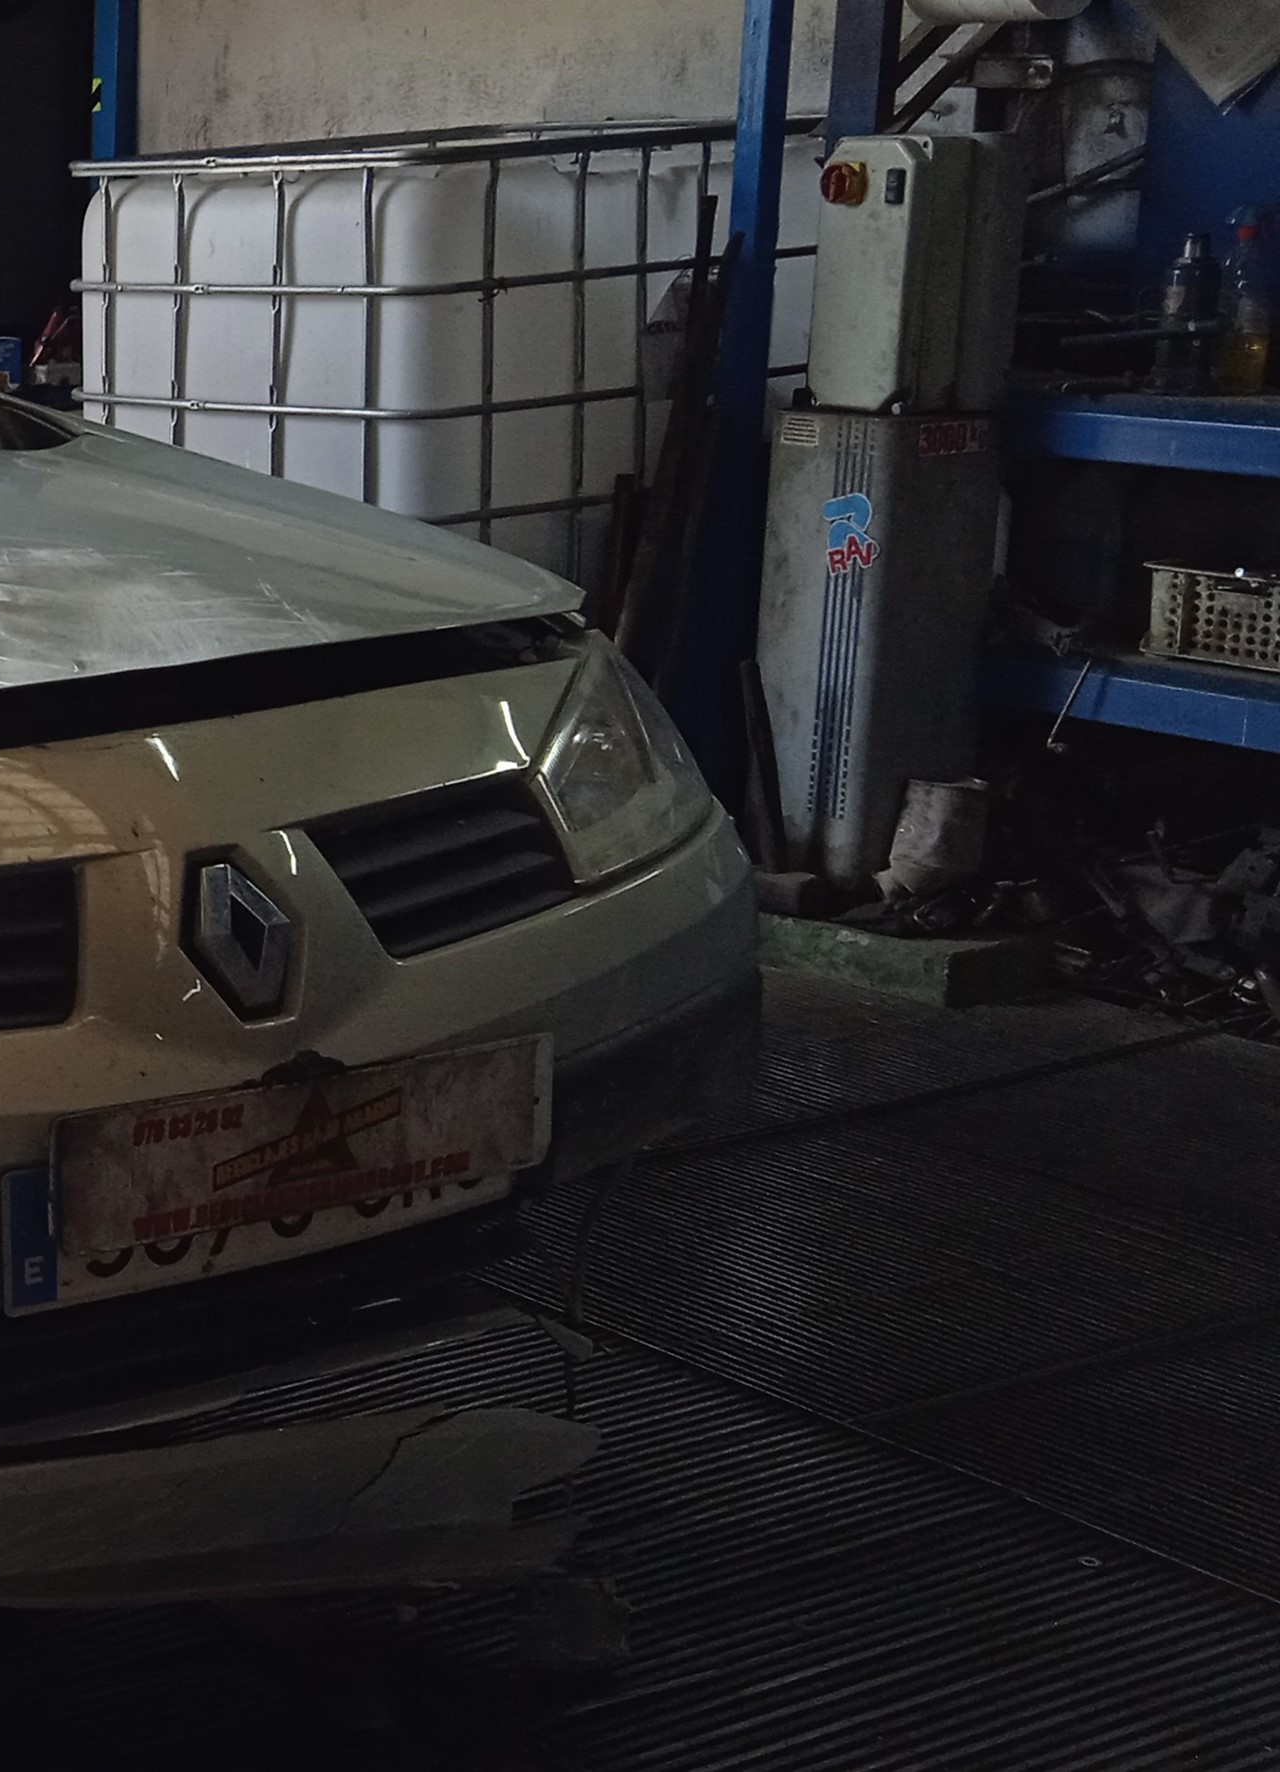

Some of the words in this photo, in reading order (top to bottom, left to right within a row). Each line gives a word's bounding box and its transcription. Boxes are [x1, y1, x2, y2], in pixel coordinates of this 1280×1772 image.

[920, 423, 967, 454] 3000
[827, 534, 873, 575] RAV
[23, 1256, 44, 1286] E
